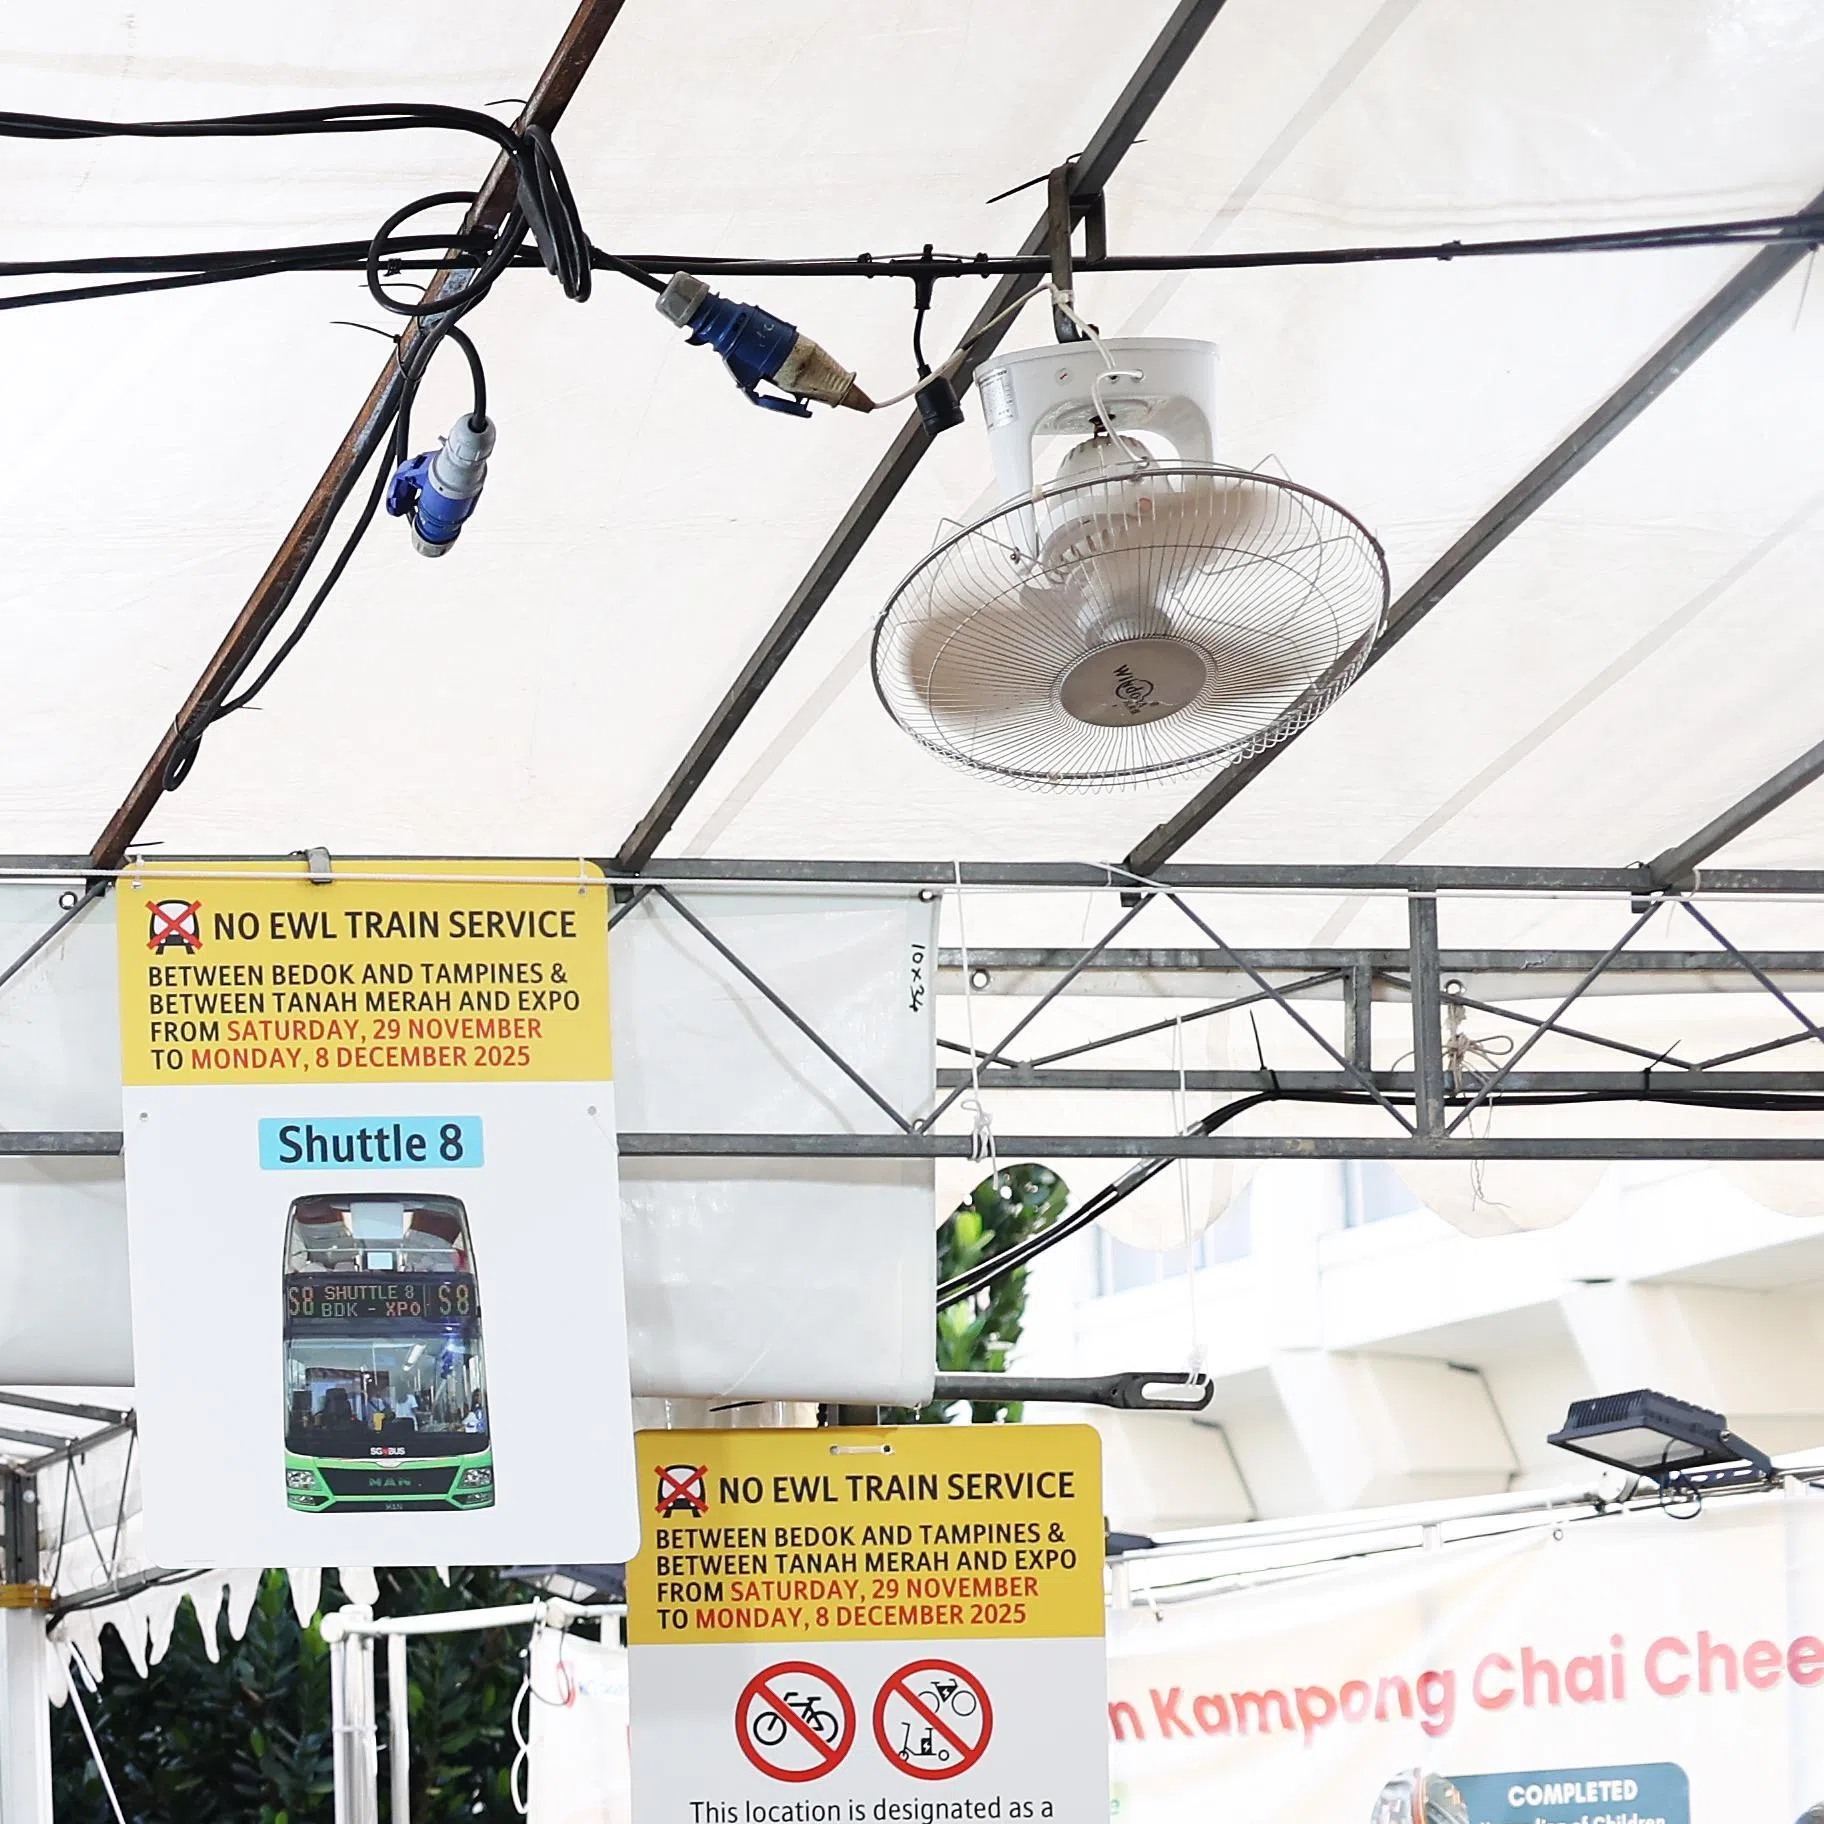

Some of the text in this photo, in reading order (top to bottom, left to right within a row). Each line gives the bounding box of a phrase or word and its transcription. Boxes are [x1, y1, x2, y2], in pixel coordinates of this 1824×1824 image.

[278, 1123, 464, 1164] Shuttle 8
[1149, 1667, 1456, 1748] Kampong
[1473, 1634, 1629, 1711] Chai
[1508, 1779, 1639, 1807] COMPLETED
[689, 1800, 738, 1824] This
[745, 1799, 841, 1823] location
[848, 1799, 866, 1822] is
[1009, 1801, 1034, 1819] as
[1041, 1800, 1053, 1818] a
